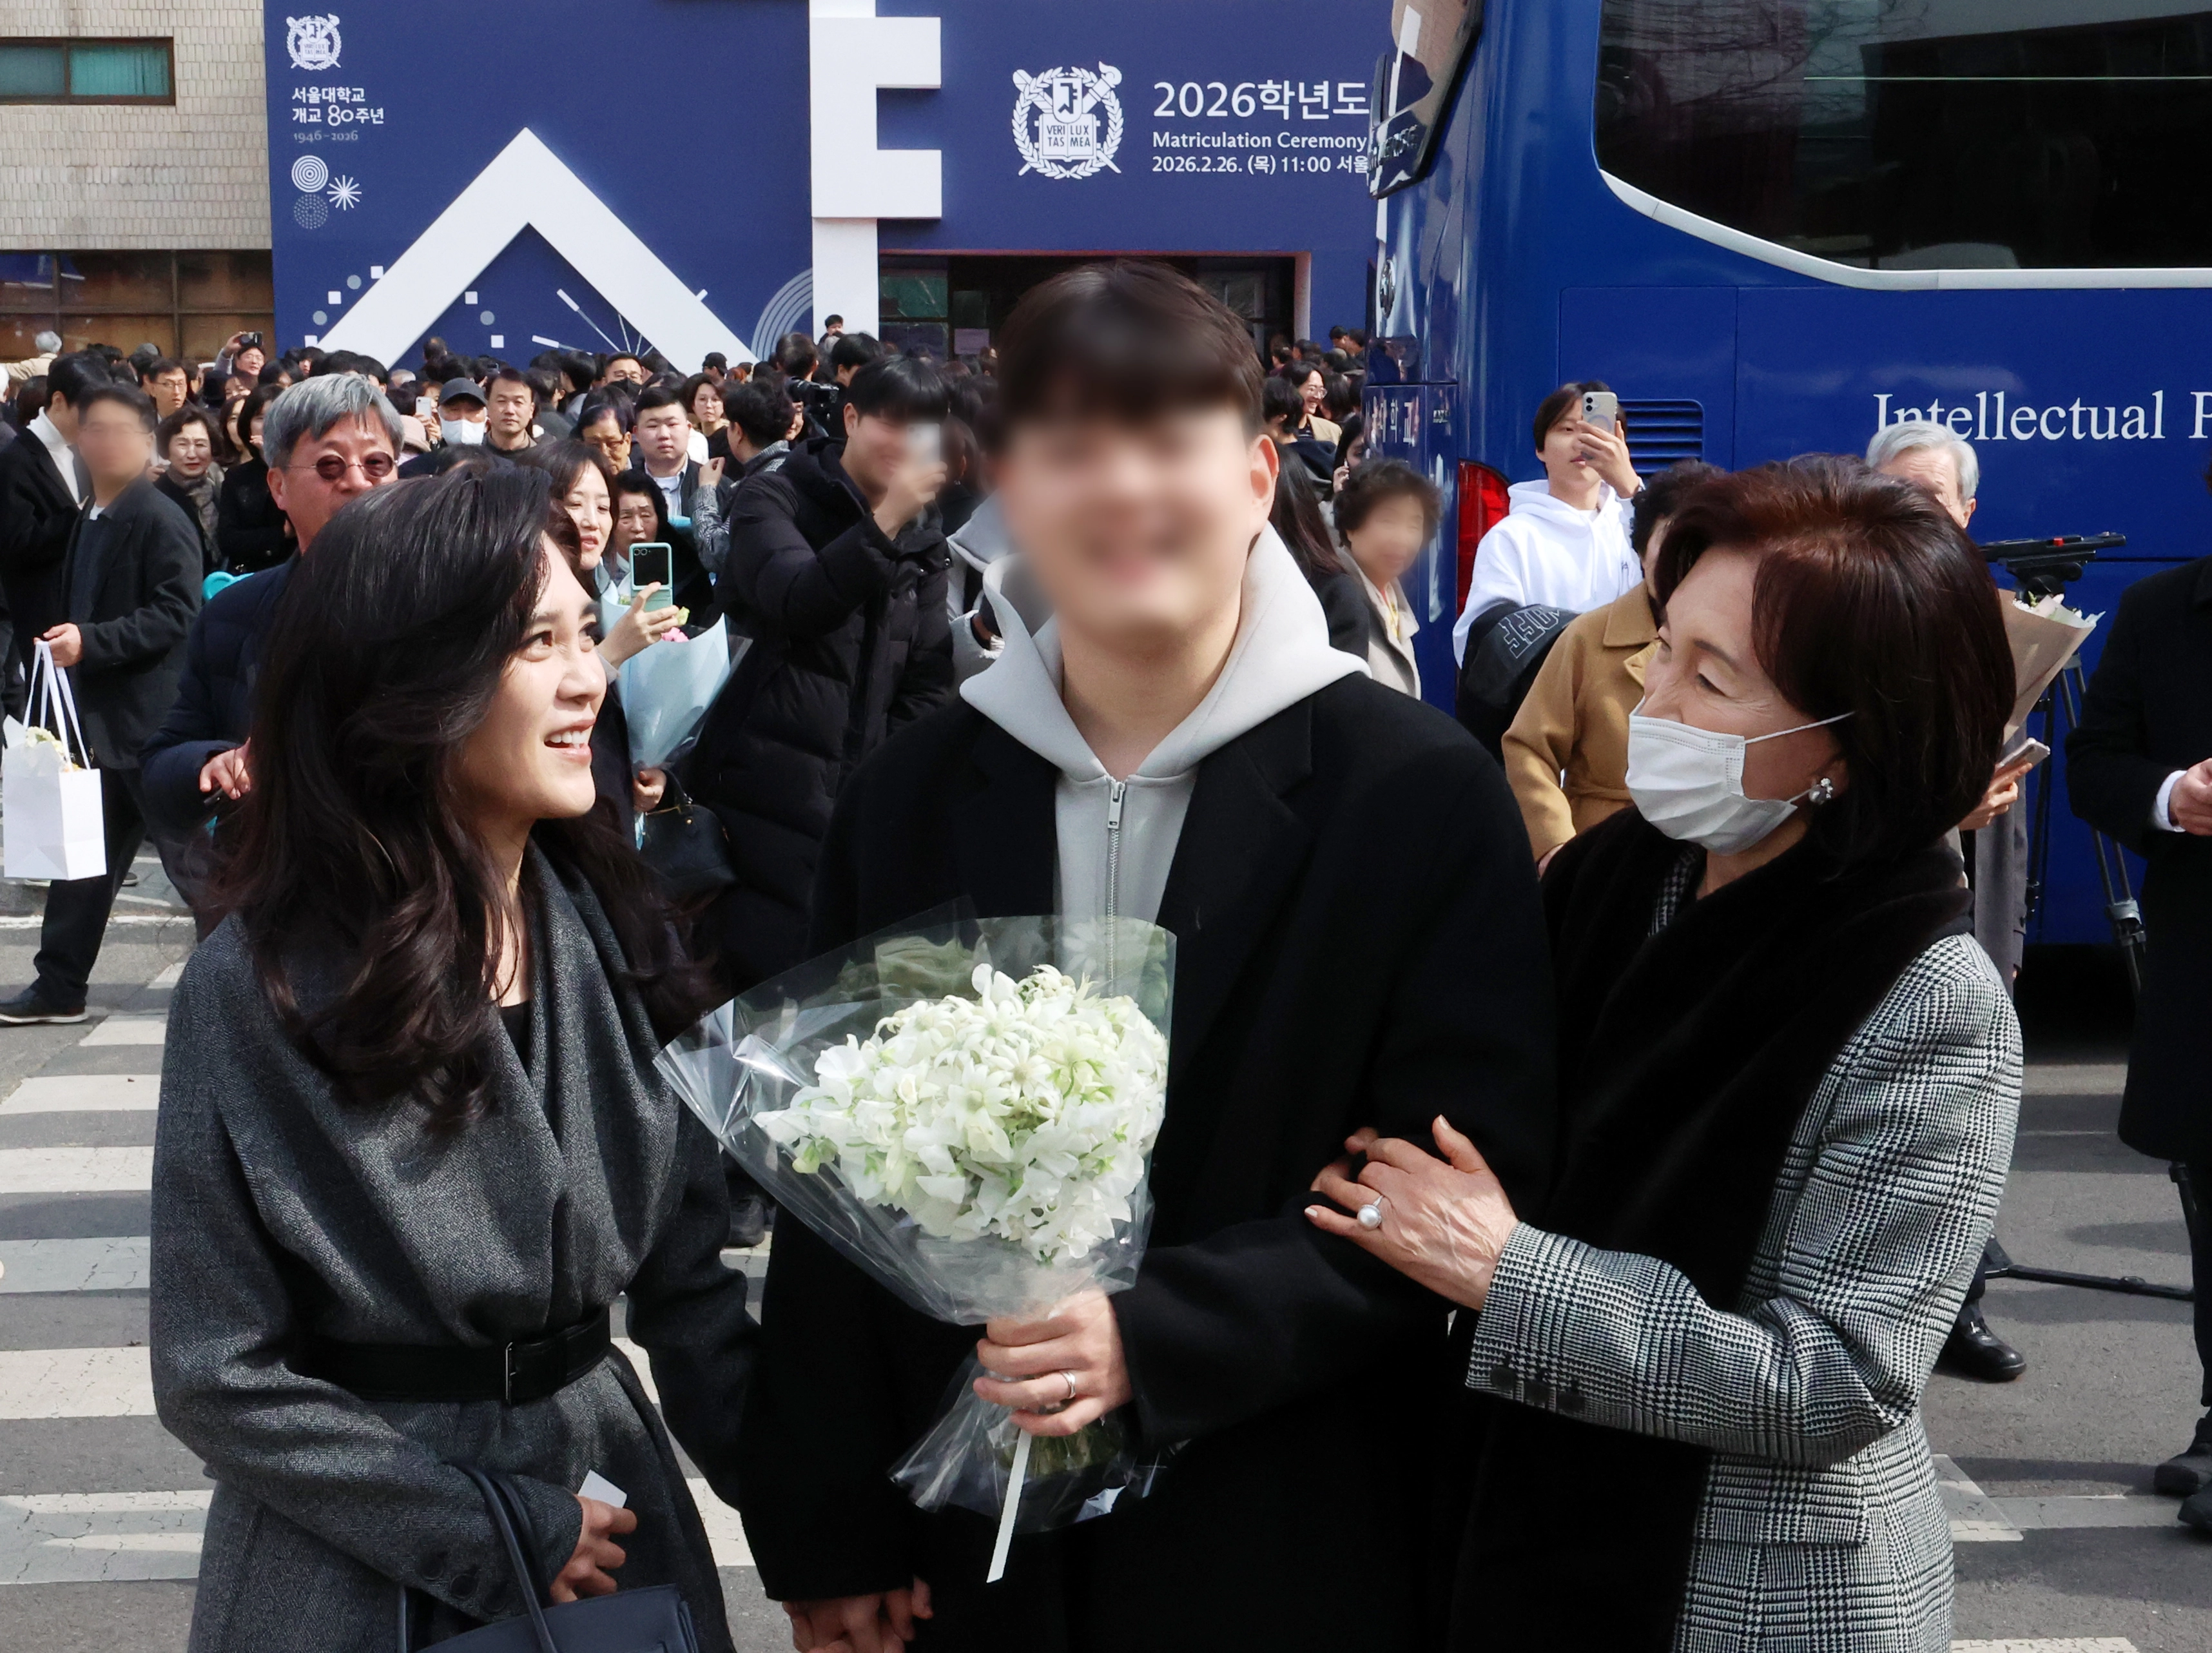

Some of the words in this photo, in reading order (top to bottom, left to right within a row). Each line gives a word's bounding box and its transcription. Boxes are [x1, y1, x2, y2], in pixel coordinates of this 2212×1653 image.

[291, 86, 366, 104] 서울대학교
[1154, 79, 1370, 121] 2026학년도
[292, 107, 322, 124] 개교
[327, 104, 385, 126] 80주년
[1046, 125, 1065, 135] VERI
[1070, 125, 1089, 135] LUX
[1047, 137, 1065, 147] TAS
[1070, 137, 1091, 147] MEA
[1152, 131, 1272, 148] Matriculation
[1277, 132, 1368, 153] Ceremony
[1152, 155, 1243, 173] 2026.2.26.
[1247, 154, 1277, 175] (목)
[1281, 156, 1332, 173] 11:00
[1872, 389, 2166, 441] Intellectual
